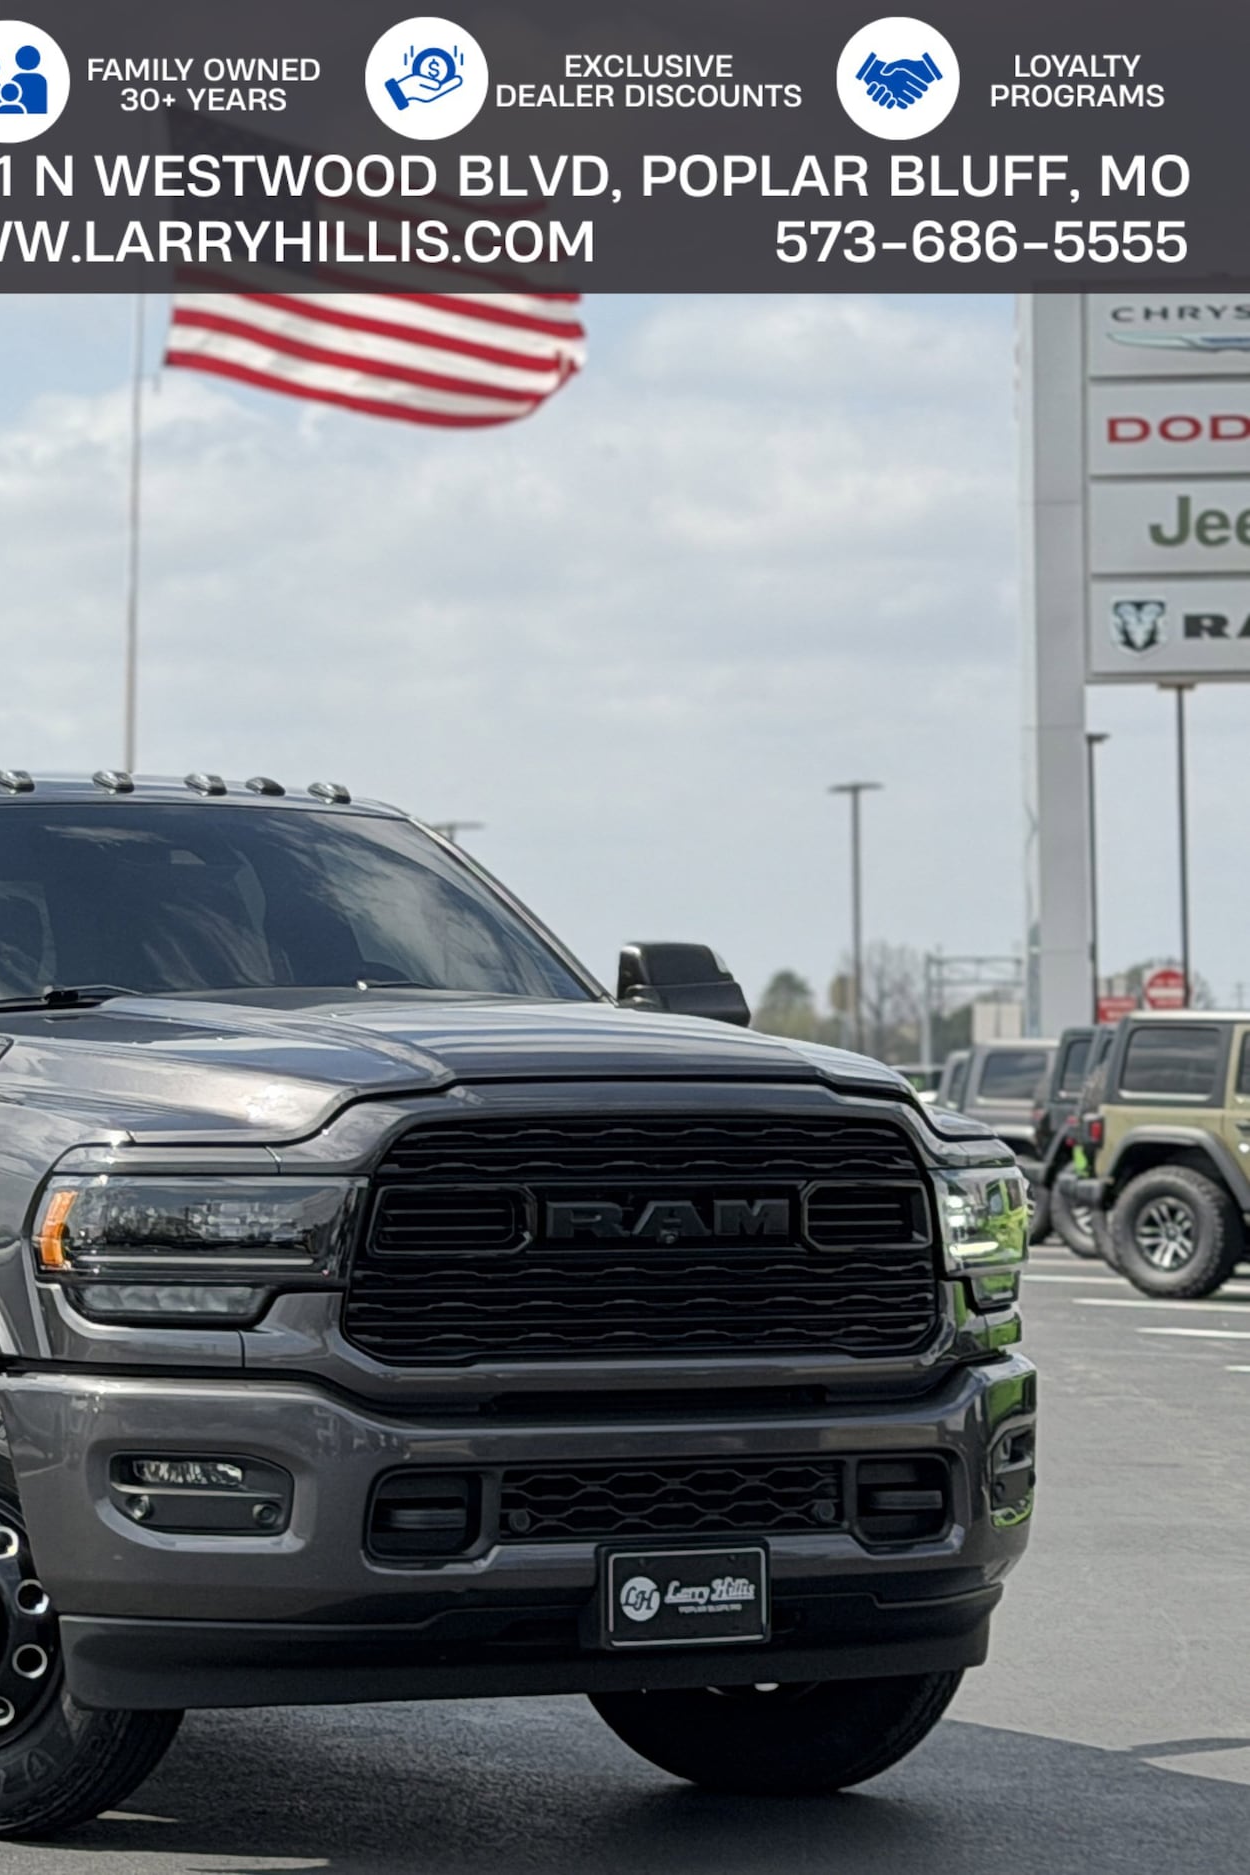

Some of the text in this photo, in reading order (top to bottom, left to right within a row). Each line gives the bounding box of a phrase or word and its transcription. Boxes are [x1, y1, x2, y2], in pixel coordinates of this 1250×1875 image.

[1107, 414, 1250, 443] DOD
[1184, 614, 1250, 640] R
[546, 1199, 789, 1239] RAM
